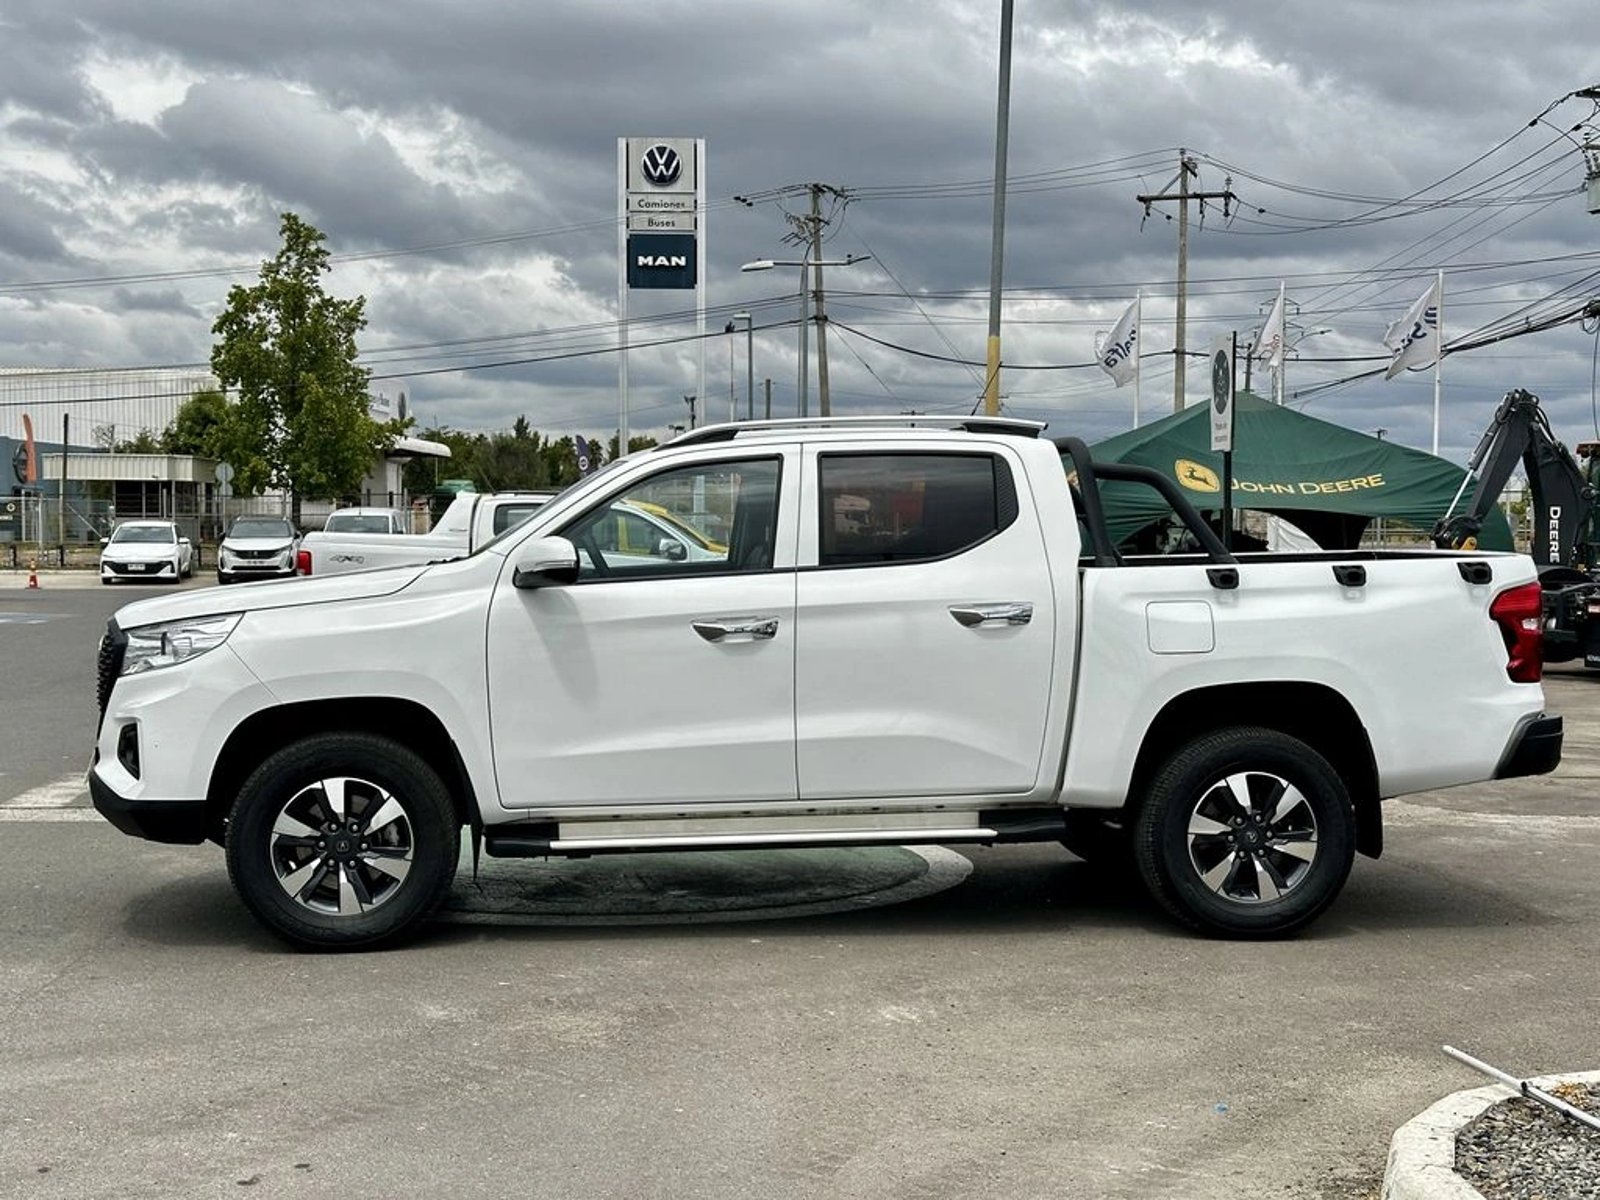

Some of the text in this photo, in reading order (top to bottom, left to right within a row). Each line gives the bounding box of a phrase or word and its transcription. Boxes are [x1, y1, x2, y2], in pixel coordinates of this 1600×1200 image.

[637, 199, 685, 209] Camiones
[647, 218, 676, 227] Buses
[637, 255, 686, 266] MAN
[1299, 473, 1386, 495] DEERE
[1550, 506, 1561, 563] DEERE
